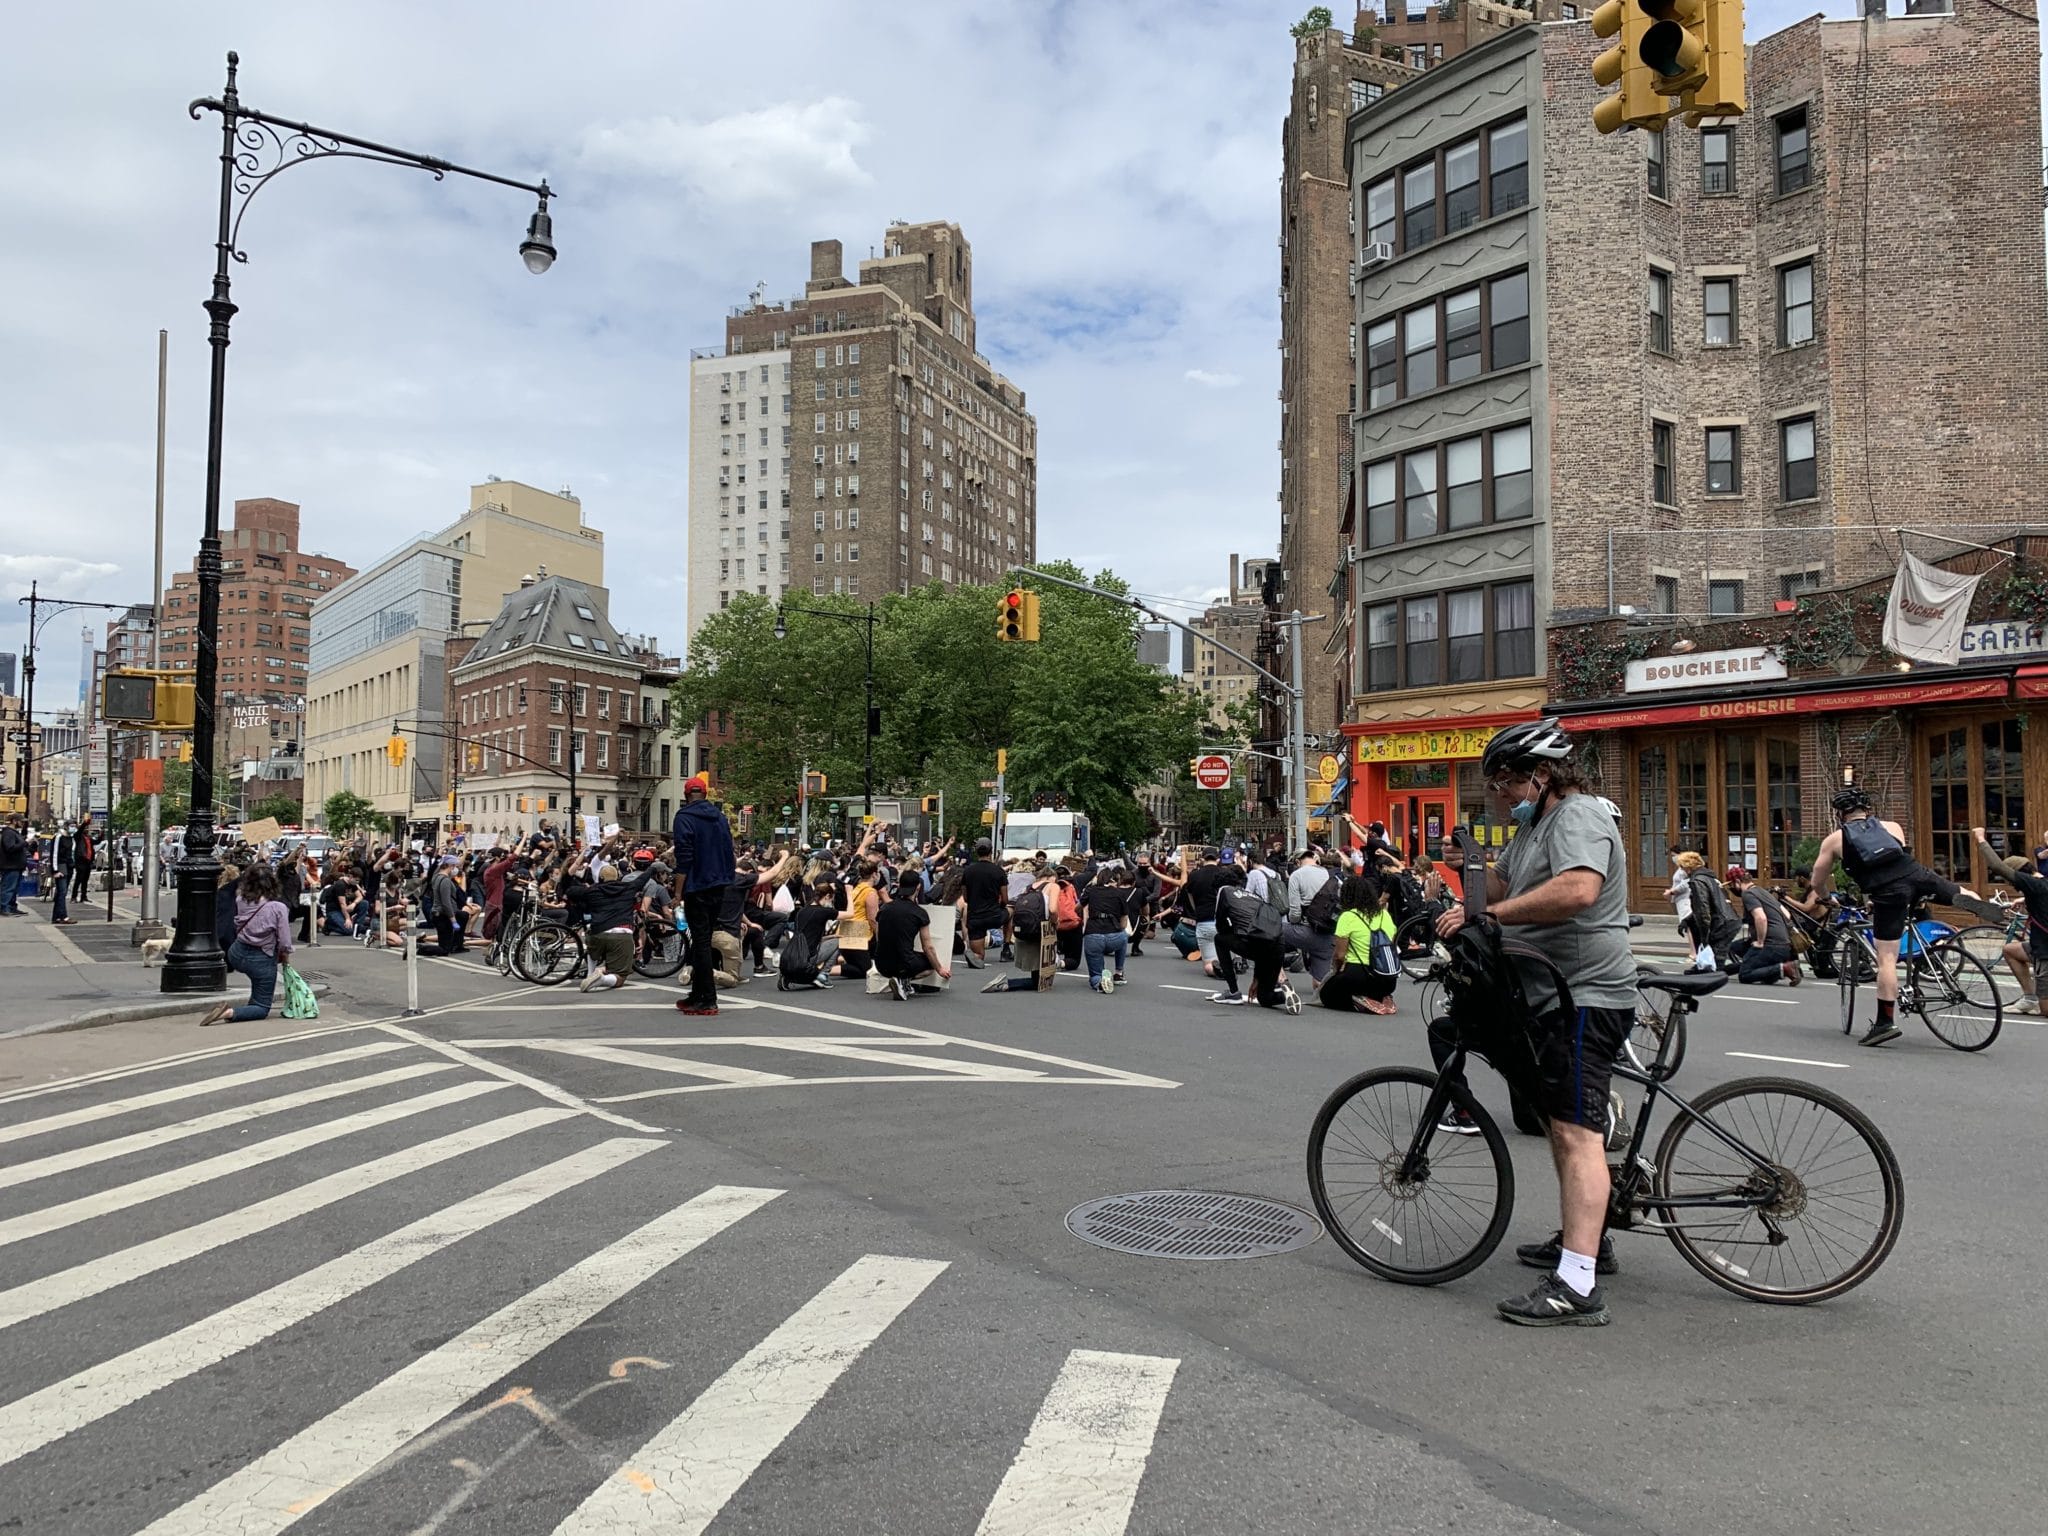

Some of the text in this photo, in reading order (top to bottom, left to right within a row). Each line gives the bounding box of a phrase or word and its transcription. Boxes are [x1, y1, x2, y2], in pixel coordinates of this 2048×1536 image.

[1645, 656, 1762, 681] BOUCHERIE
[1814, 695, 1865, 706] BREAKFAST
[1873, 691, 1911, 702] BRUNCH
[233, 705, 269, 717] MAGIC
[1699, 698, 1797, 718] BOUCHERIE
[1598, 714, 1649, 724] RESTAURANT
[1546, 1294, 1575, 1315] N
